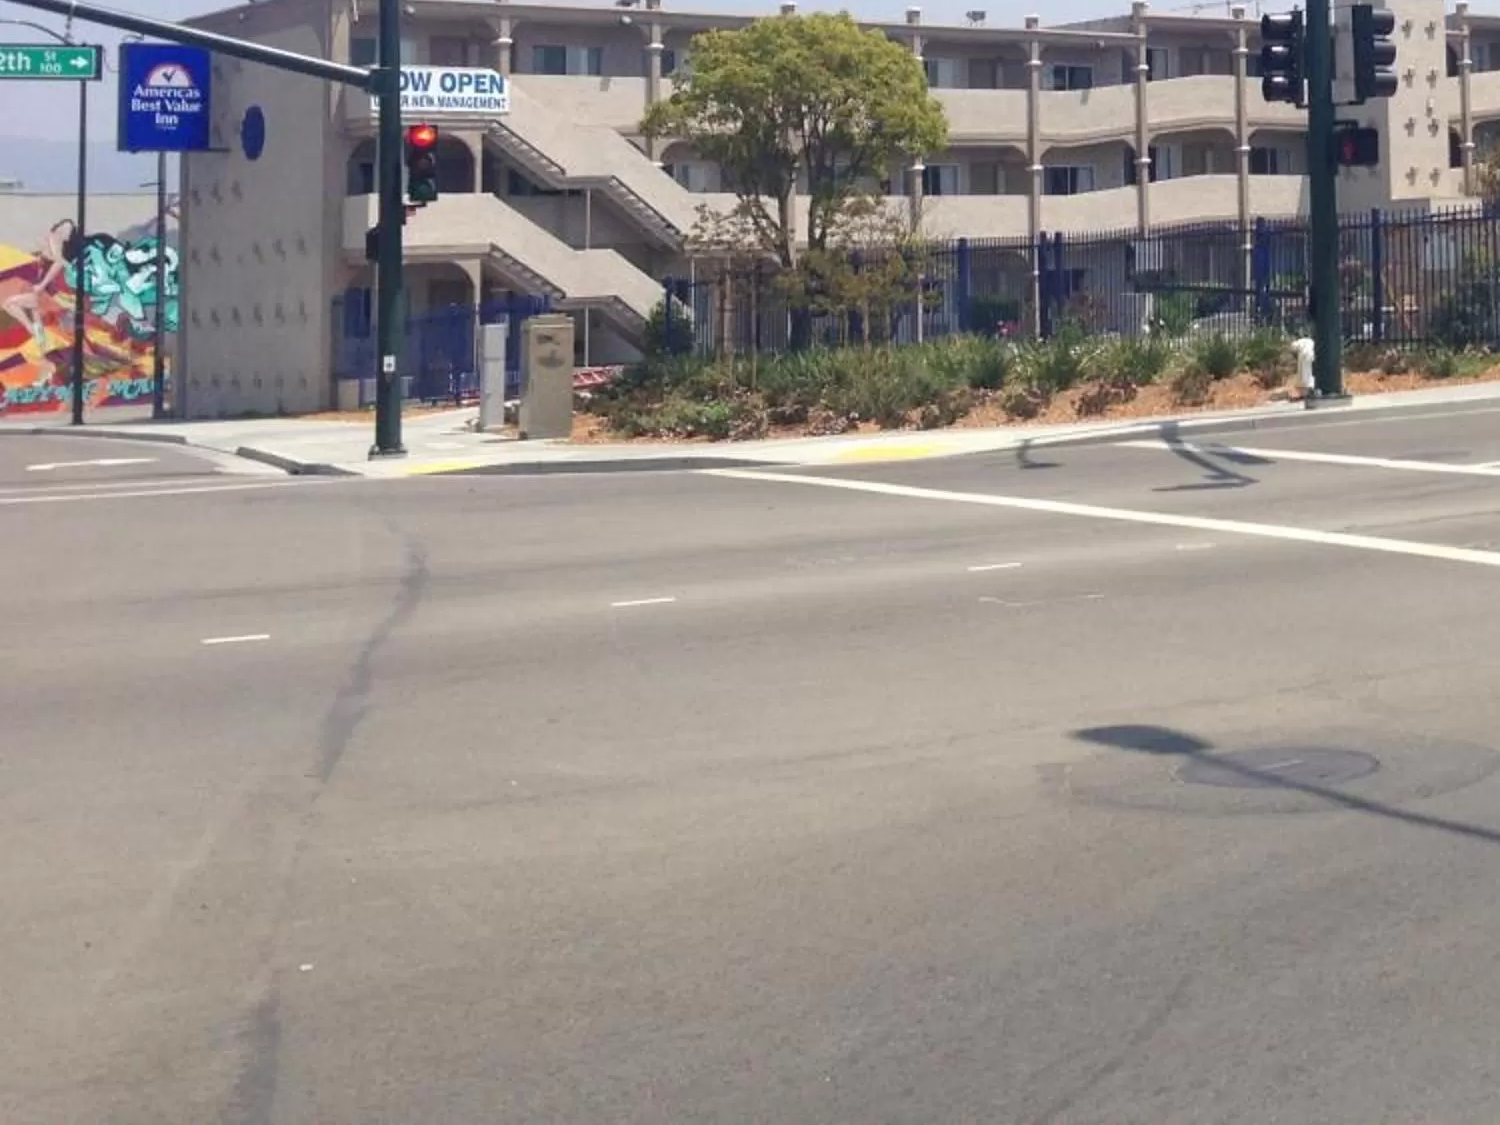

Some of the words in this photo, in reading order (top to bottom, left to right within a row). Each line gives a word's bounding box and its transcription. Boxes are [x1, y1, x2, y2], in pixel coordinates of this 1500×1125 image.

[400, 70, 432, 92] OW
[440, 72, 505, 94] OPEN
[133, 83, 201, 98] Americas
[131, 99, 161, 112] Best
[165, 99, 201, 112] Value
[438, 97, 507, 109] MANAGEMENT
[155, 112, 179, 125] Inn
